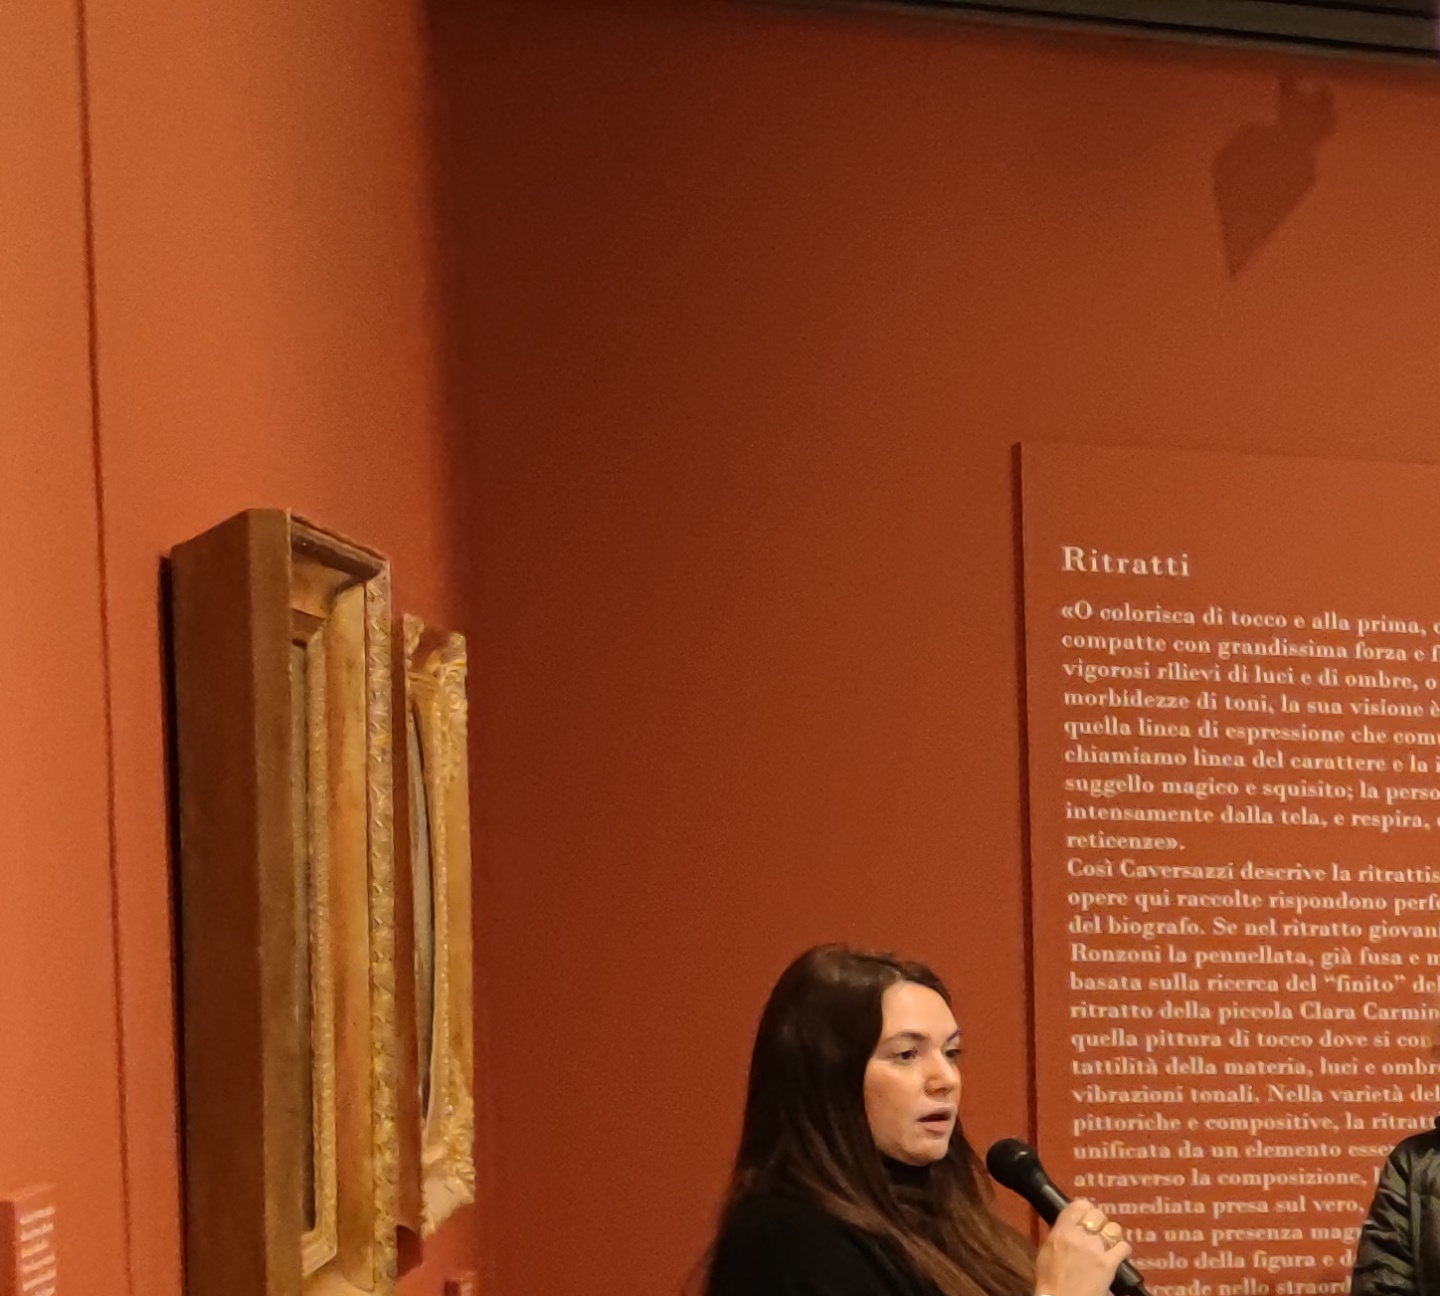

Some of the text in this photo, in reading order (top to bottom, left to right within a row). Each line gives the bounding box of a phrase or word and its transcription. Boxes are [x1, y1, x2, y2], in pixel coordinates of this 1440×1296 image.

[1061, 545, 1191, 577] Ritratti
[1061, 600, 1093, 619] «O
[1100, 602, 1195, 624] colorisca
[1203, 606, 1223, 625] di
[1231, 611, 1287, 627] tocco
[1294, 616, 1305, 628] e
[1312, 611, 1350, 630] alla
[1358, 615, 1426, 637] prima,
[1061, 635, 1166, 655] compatte
[1173, 639, 1210, 653] con
[1218, 638, 1348, 659] grandissima
[1355, 641, 1407, 661] forza
[1414, 649, 1424, 662] e
[1063, 659, 1150, 682] vigorosi
[1157, 662, 1221, 682] rilievi
[1228, 663, 1248, 683] di
[1255, 664, 1294, 685] luci
[1301, 673, 1311, 685] e
[1317, 667, 1338, 686] di
[1345, 670, 1418, 692] ombre,
[1425, 677, 1437, 690] o
[1064, 688, 1190, 709] morbidezze
[1196, 691, 1217, 710] di
[1224, 695, 1274, 714] toni,
[1281, 694, 1300, 713] la
[1307, 701, 1342, 715] sua
[1350, 698, 1424, 718] visione
[1430, 699, 1440, 717] è
[1064, 716, 1131, 740] quella
[1139, 717, 1191, 738] linea
[1198, 719, 1218, 739] di
[1225, 724, 1345, 745] espressione
[1351, 725, 1387, 744] che
[1065, 744, 1187, 766] chiamiamo
[1194, 747, 1245, 768] linea
[1252, 750, 1283, 769] del
[1290, 755, 1386, 772] carattere
[1393, 759, 1403, 773] e
[1410, 754, 1428, 773] la
[1065, 774, 1154, 797] suggello
[1162, 778, 1239, 799] magico
[1245, 783, 1256, 796] e
[1263, 780, 1353, 803] squisito;
[1360, 780, 1379, 799] la
[1066, 802, 1214, 823] intensamente
[1220, 805, 1273, 825] dalla
[1281, 806, 1328, 827] tela,
[1333, 813, 1344, 826] e
[1352, 810, 1430, 834] respira,
[1067, 858, 1113, 877] Così
[1119, 859, 1233, 880] Caversazzi
[1240, 860, 1326, 881] descrive
[1332, 863, 1351, 882] la
[1068, 893, 1128, 911] opere
[1135, 889, 1170, 912] qui
[1177, 889, 1262, 908] raccolte
[1269, 891, 1387, 914] rispondono
[1068, 915, 1101, 934] del
[1108, 915, 1205, 940] biografo.
[1213, 917, 1237, 936] Se
[1245, 917, 1277, 936] nel
[1283, 920, 1362, 937] ritratto
[1071, 943, 1419, 970] Ronzoni la pennellata, già fusa e
[1070, 971, 1142, 991] basata
[1149, 972, 1200, 992] sulla
[1208, 974, 1278, 992] ricerca
[1286, 973, 1316, 991] del
[1070, 1000, 1440, 1025] ritratto della piccola Clara Carmin
[1071, 1029, 1390, 1053] quella pittura di tocco dove si
[1072, 1056, 1158, 1075] tattilità
[1165, 1056, 1217, 1074] della
[1224, 1057, 1313, 1076] materia,
[1320, 1056, 1358, 1075] luci
[1364, 1062, 1376, 1074] e
[1072, 1084, 1183, 1103] vibrazioni
[1191, 1084, 1259, 1102] tonali.
[1268, 1084, 1323, 1102] Nella
[1330, 1084, 1404, 1103] varietà
[1073, 1111, 1364, 1136] pittoriche e compositive, la
[1073, 1140, 1341, 1159] unificata da un elemento
[1074, 1172, 1185, 1187] attraverso
[1191, 1168, 1211, 1186] la
[1217, 1168, 1367, 1191] composizione,
[1212, 1194, 1365, 1220] presa sul vero,
[1164, 1229, 1204, 1242] una
[1211, 1227, 1303, 1247] presenza
[1194, 1252, 1245, 1270] della
[1253, 1250, 1316, 1272] figura
[1322, 1255, 1334, 1267] e
[1218, 1275, 1350, 1296] nello straord
